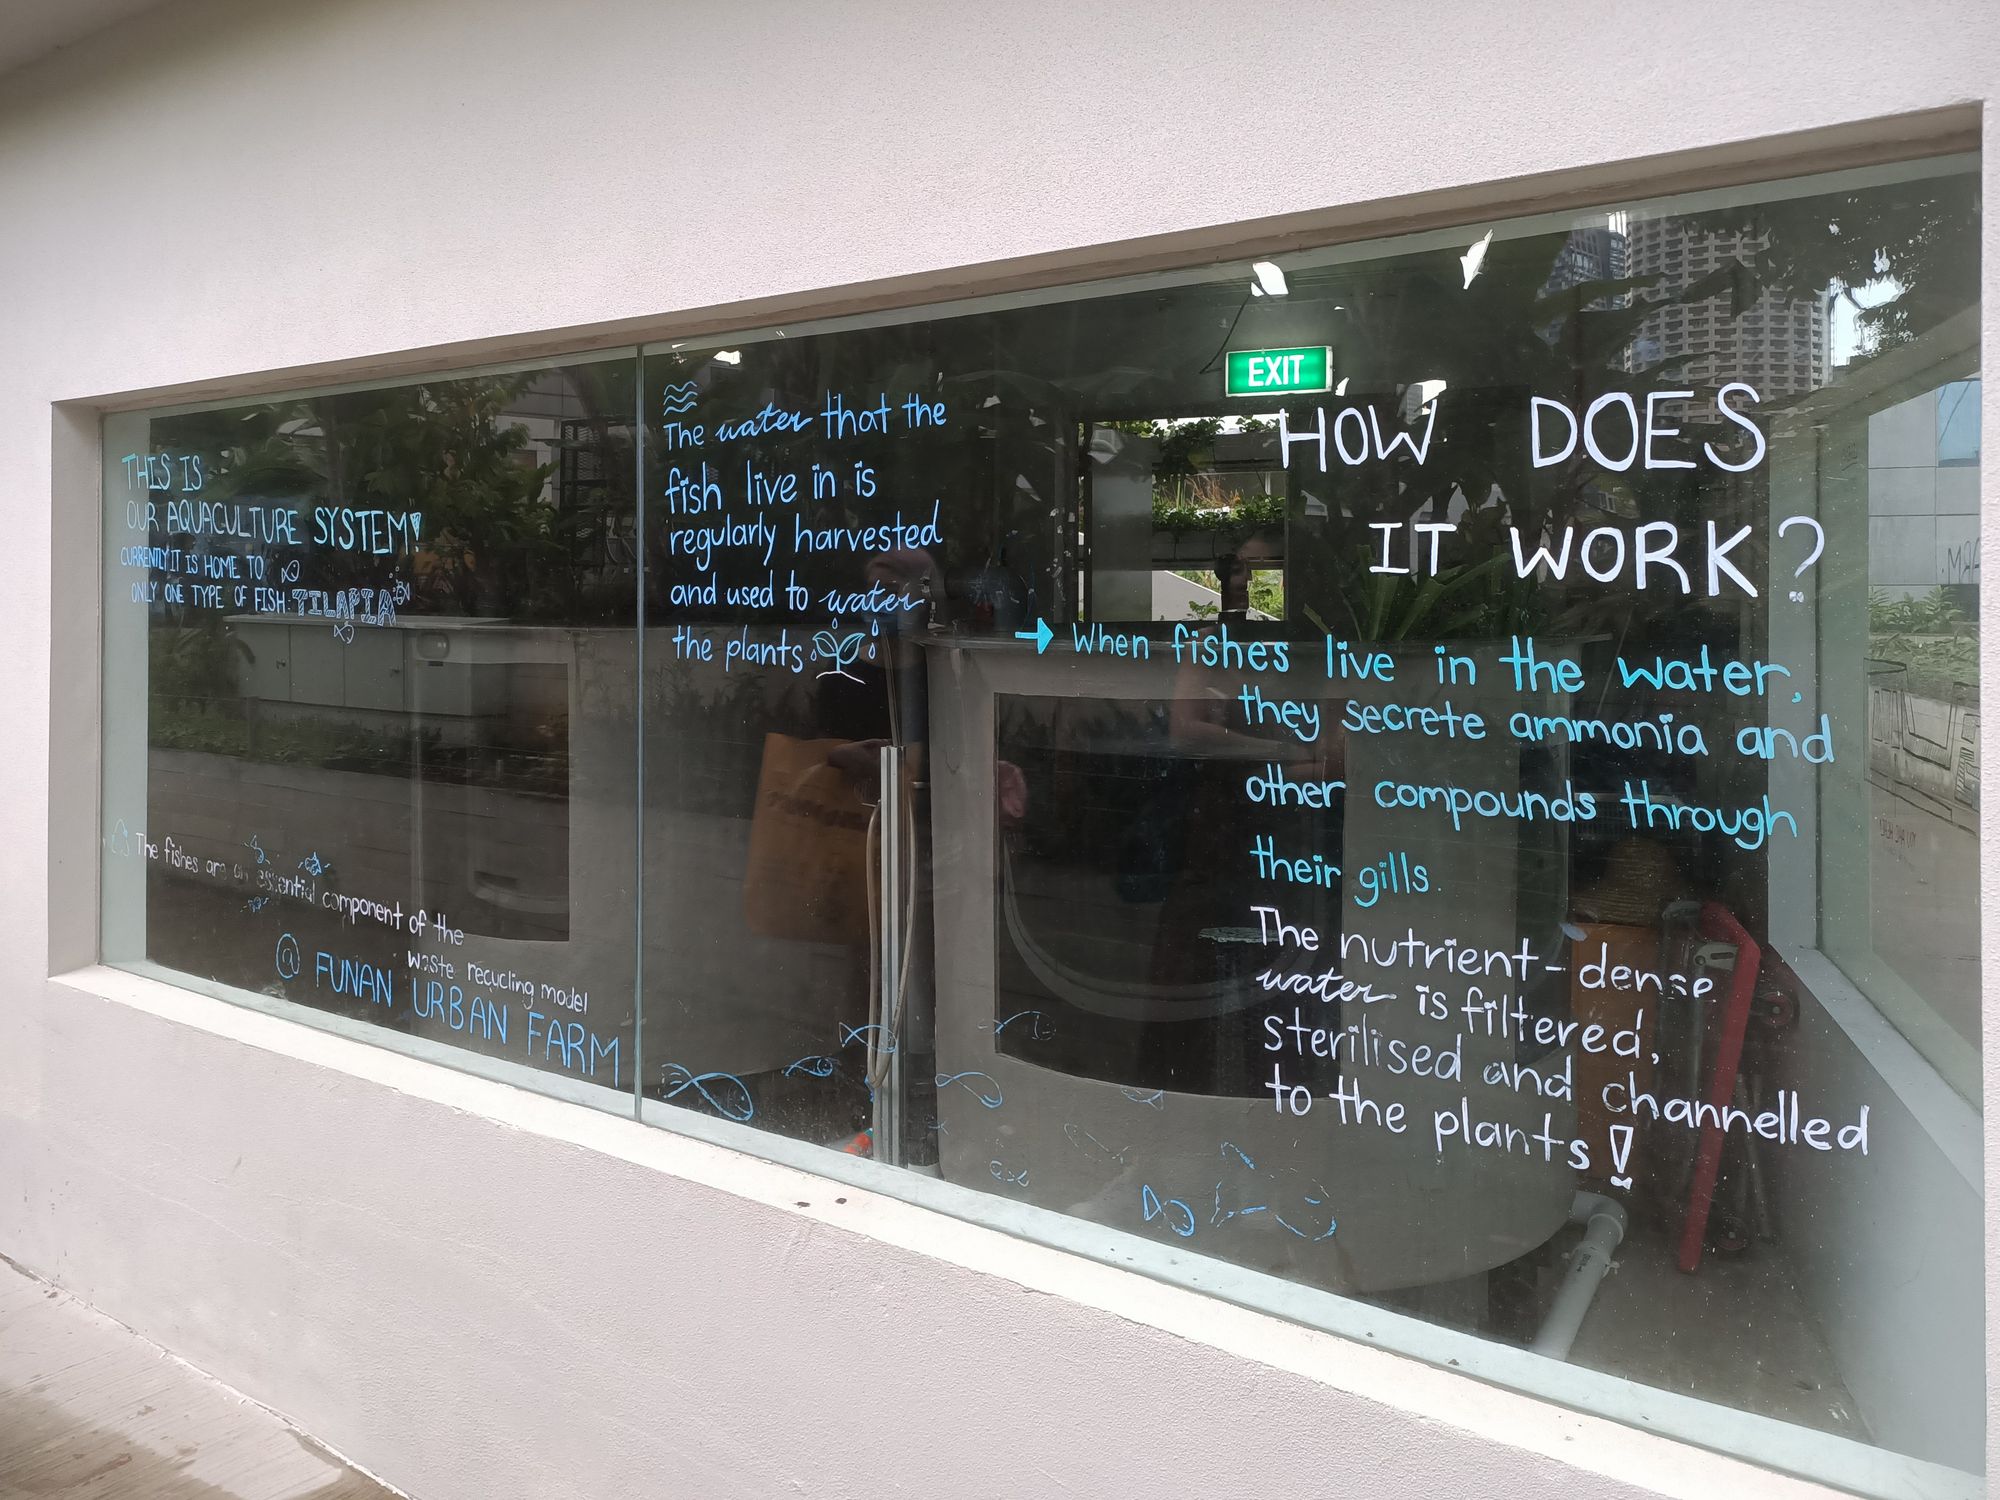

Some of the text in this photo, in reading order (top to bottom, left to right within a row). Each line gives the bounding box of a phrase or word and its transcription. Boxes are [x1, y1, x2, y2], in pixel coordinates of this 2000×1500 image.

[1249, 354, 1304, 387] EXIT
[663, 389, 947, 450] The water that the
[1280, 382, 1766, 472] HOW DOES
[122, 453, 202, 492] THIS IS
[665, 460, 876, 515] fish live in is
[126, 499, 422, 556] OUR AQUACULTURE SYSTEM!
[669, 499, 943, 572] regularly harvested
[1368, 523, 1458, 577] IT
[120, 547, 264, 580] CURRENTLY IT IS HOME TO
[670, 569, 926, 614] and used to water
[131, 582, 396, 626] ONLY ONE TYPE OF FISH: TILAPIA
[672, 624, 804, 674] the plants
[1072, 622, 1802, 703] When fishes live in the water,
[1238, 684, 1835, 764] they secrete ammonia and
[1246, 763, 1797, 850] other compounds through
[135, 832, 158, 860] The
[164, 836, 198, 873] fishes
[206, 859, 227, 880] are
[322, 891, 403, 930] component
[409, 909, 426, 937] of
[434, 912, 464, 946] the
[1250, 834, 1442, 908] their gills.
[1250, 905, 1320, 951] The
[276, 932, 619, 1088] @ FUNAN URBAN FARM
[407, 950, 454, 980] waste
[541, 982, 588, 1014] model
[1256, 967, 1660, 1065] water is filtered,
[1264, 1006, 1870, 1156] sterilised and channelled
[1264, 1063, 1312, 1116] to
[1328, 1074, 1407, 1133] the
